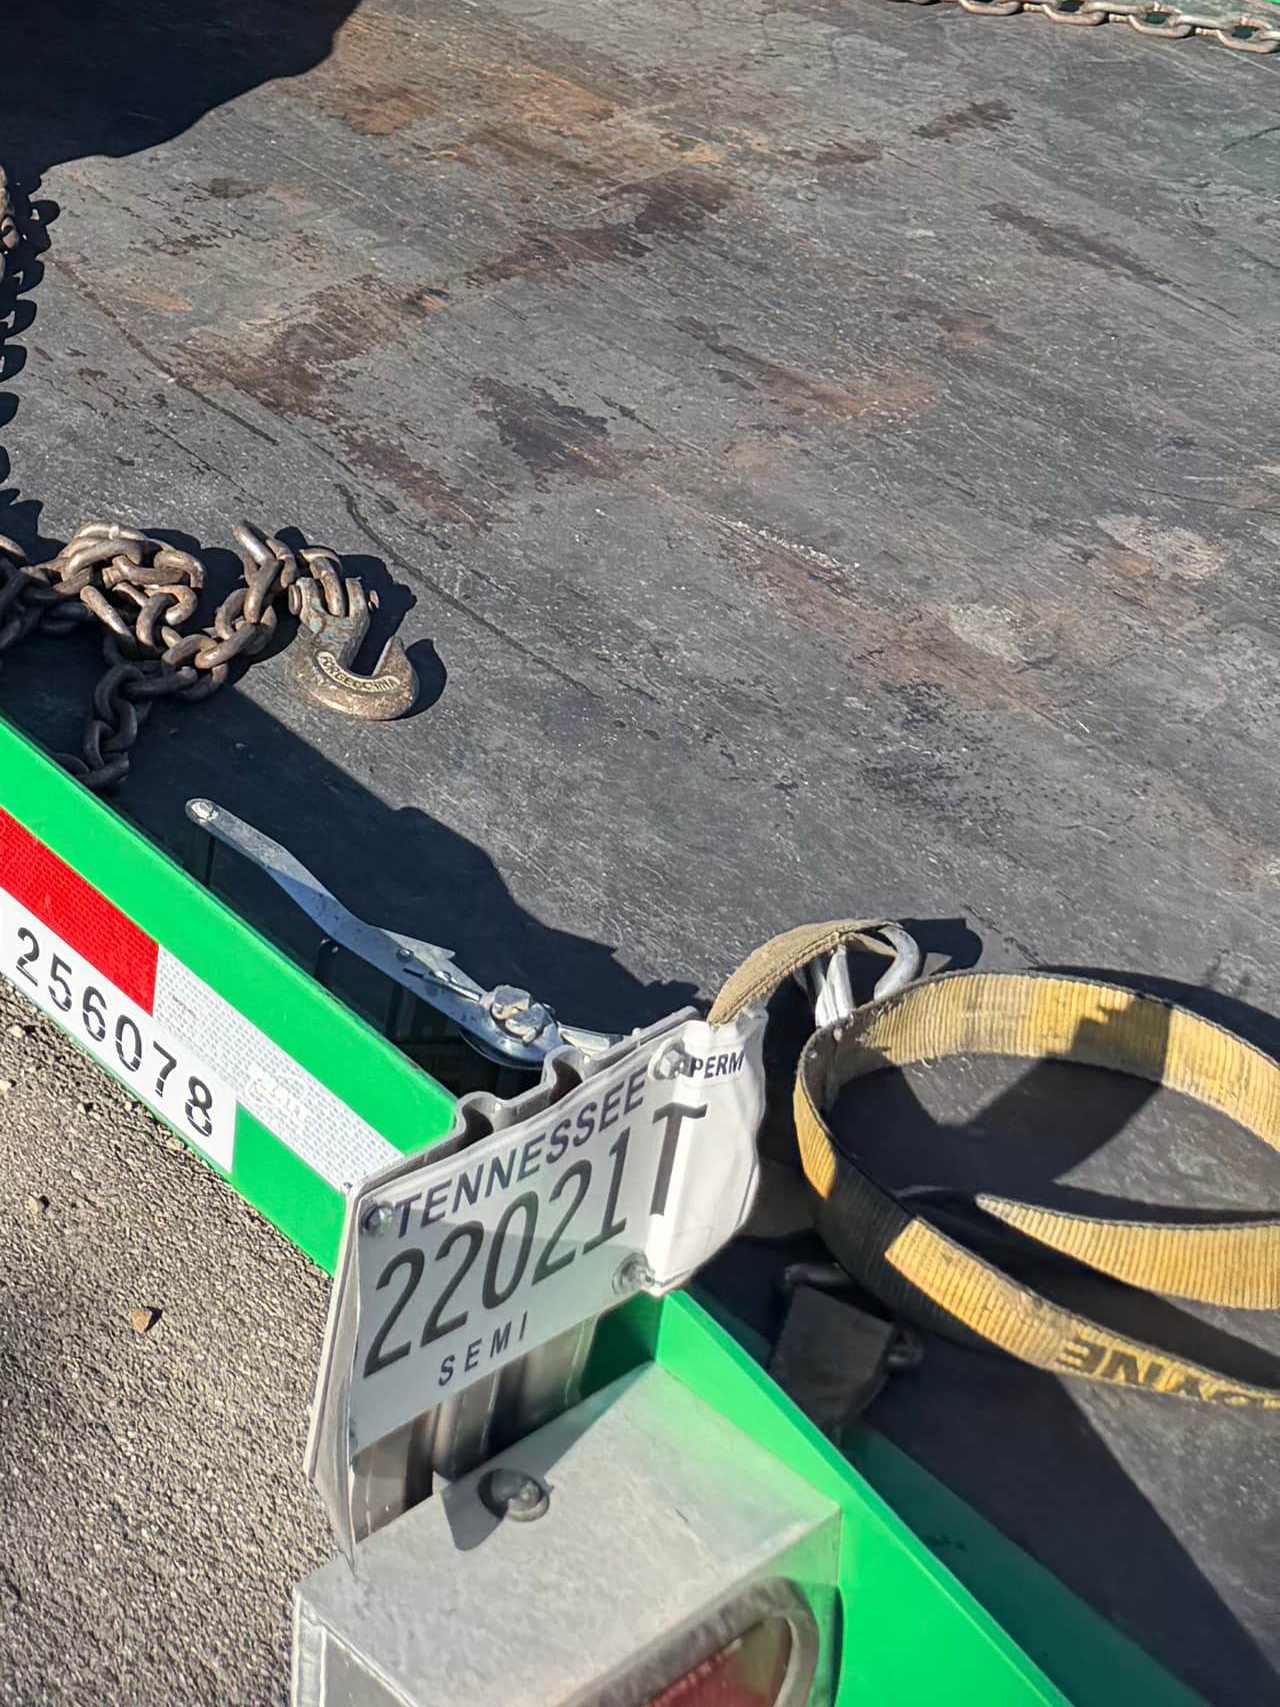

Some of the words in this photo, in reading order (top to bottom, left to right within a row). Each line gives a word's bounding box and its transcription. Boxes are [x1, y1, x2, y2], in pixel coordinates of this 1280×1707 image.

[395, 1067, 647, 1239] TENNESSEE
[689, 1050, 746, 1079] PERM
[362, 1101, 708, 1380] 22021T
[438, 1310, 529, 1387] SEMI
